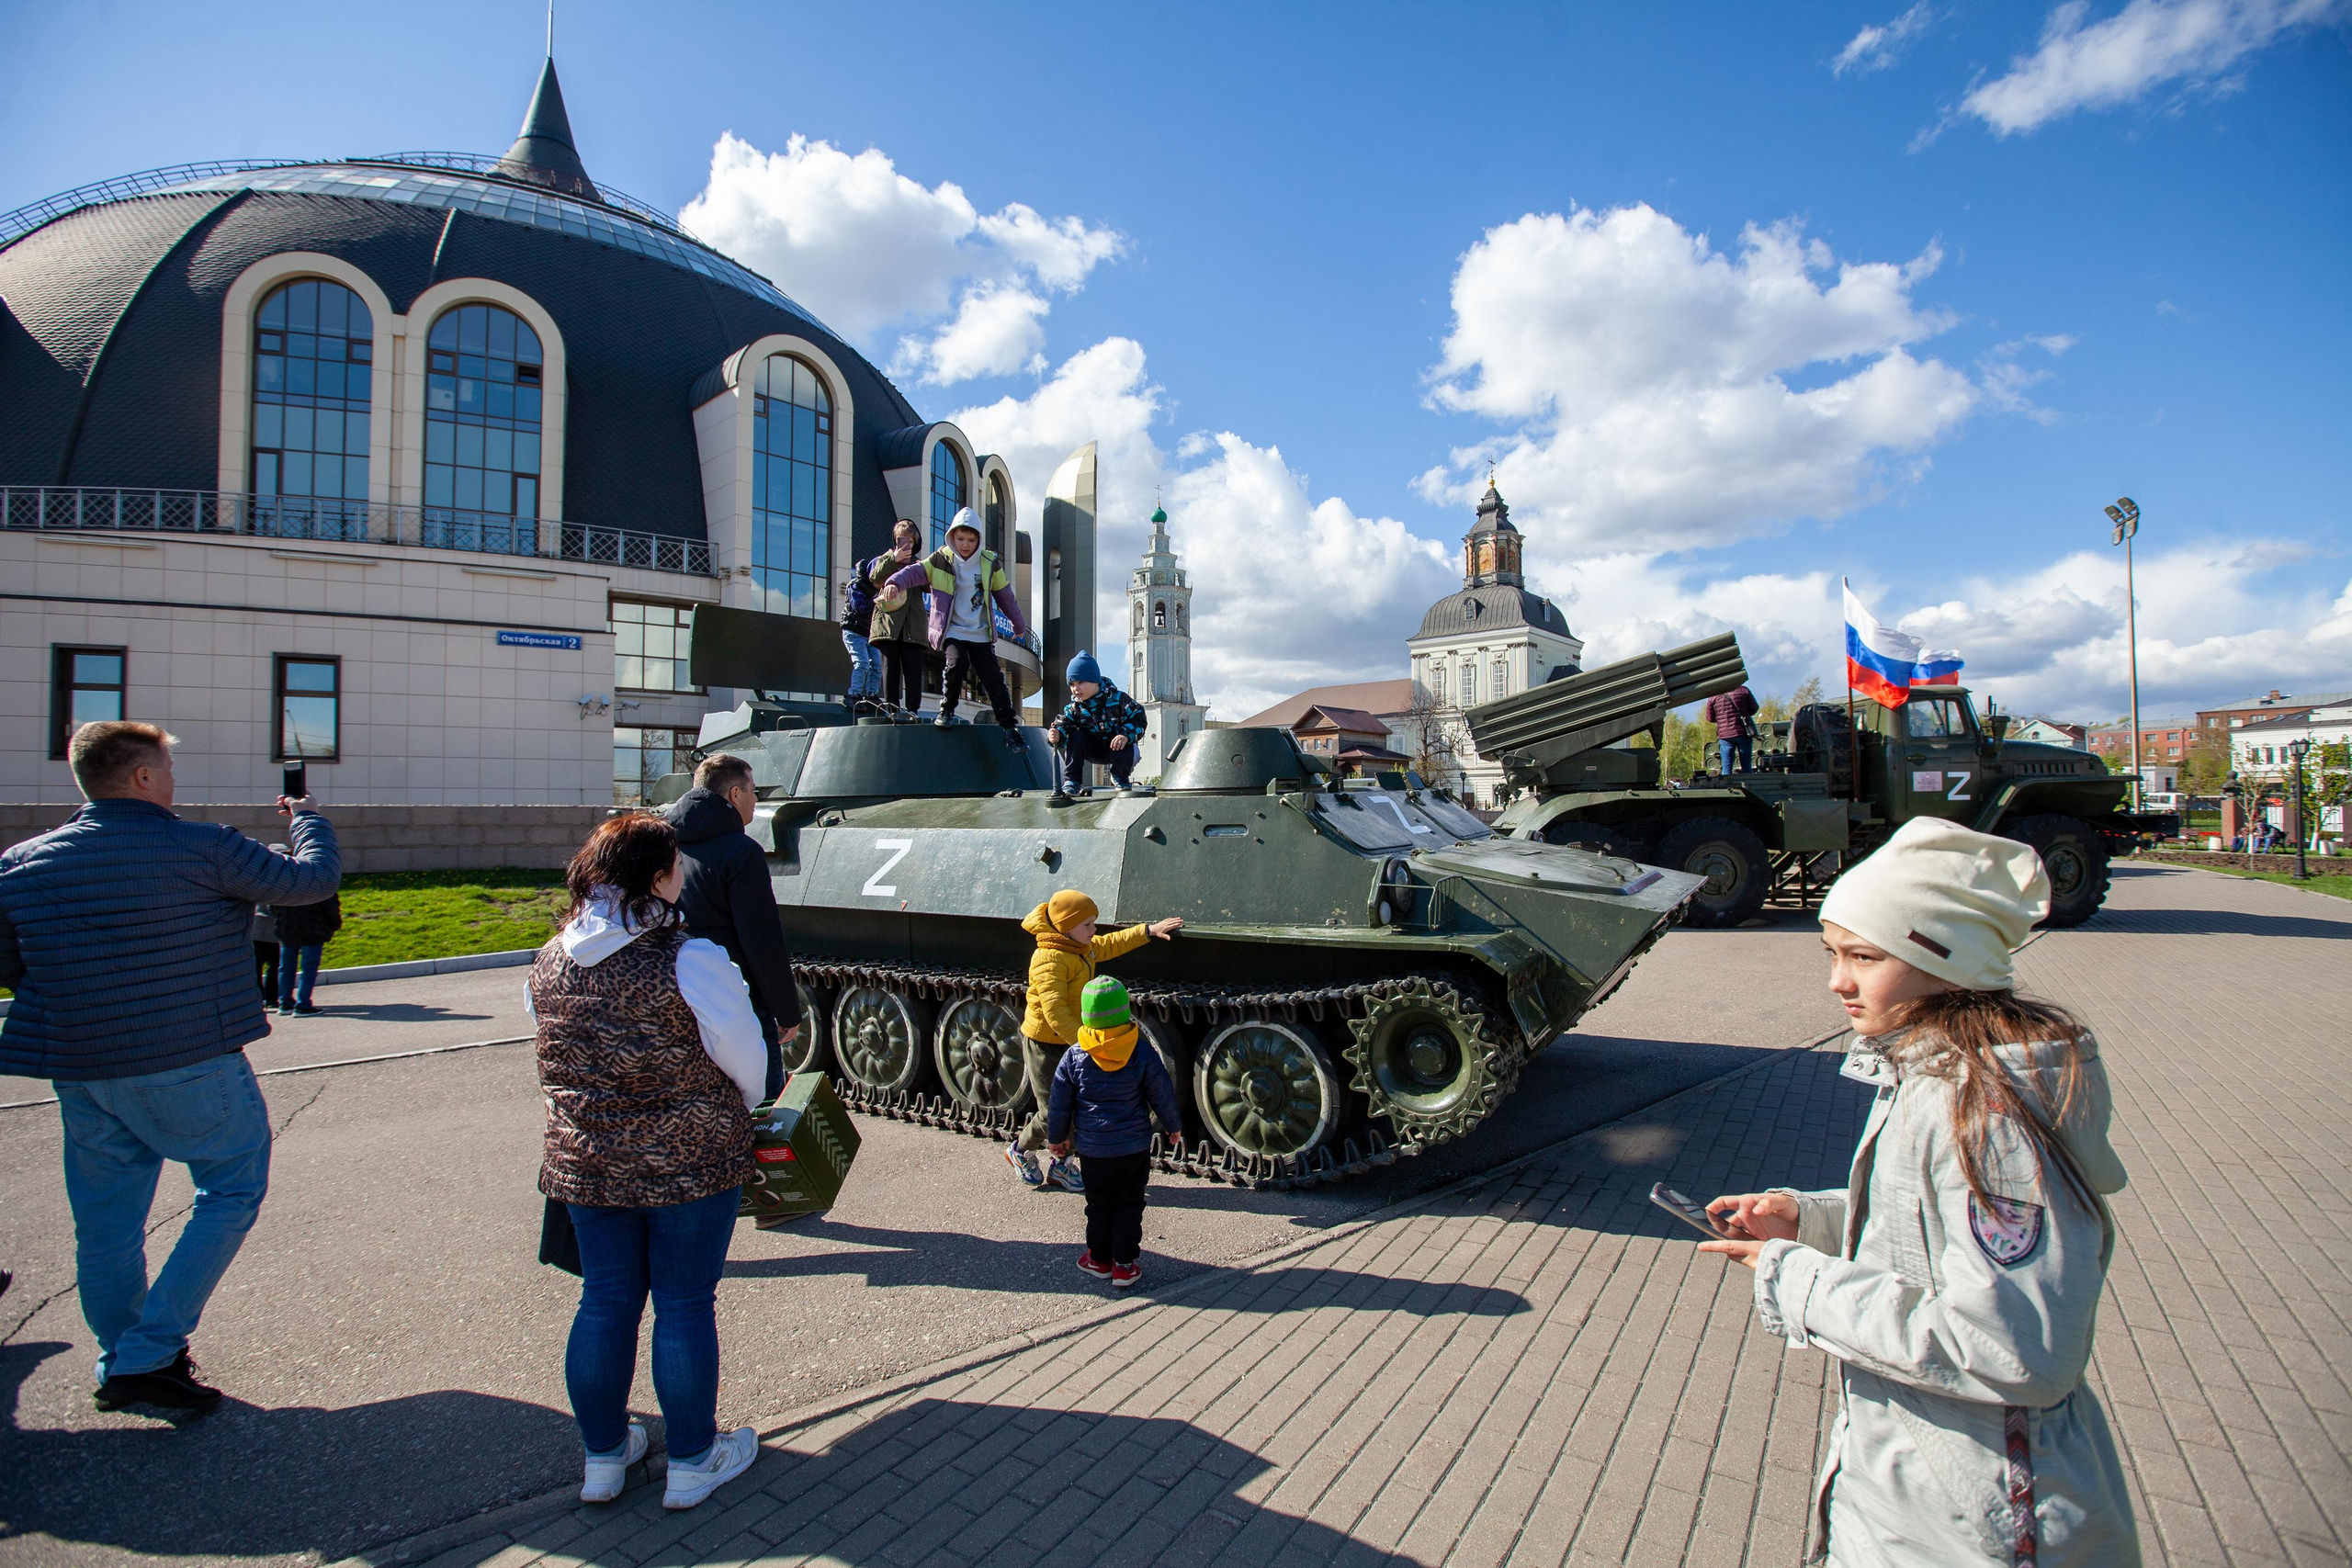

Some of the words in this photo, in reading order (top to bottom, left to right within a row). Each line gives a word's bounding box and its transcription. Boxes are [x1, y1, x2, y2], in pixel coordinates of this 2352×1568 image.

[994, 615, 1014, 634] ОБЕД
[501, 635, 561, 645] Октябрьская
[568, 637, 576, 649] 2
[1947, 771, 1971, 800] Z
[1367, 795, 1432, 834] Z
[861, 838, 913, 897] Z
